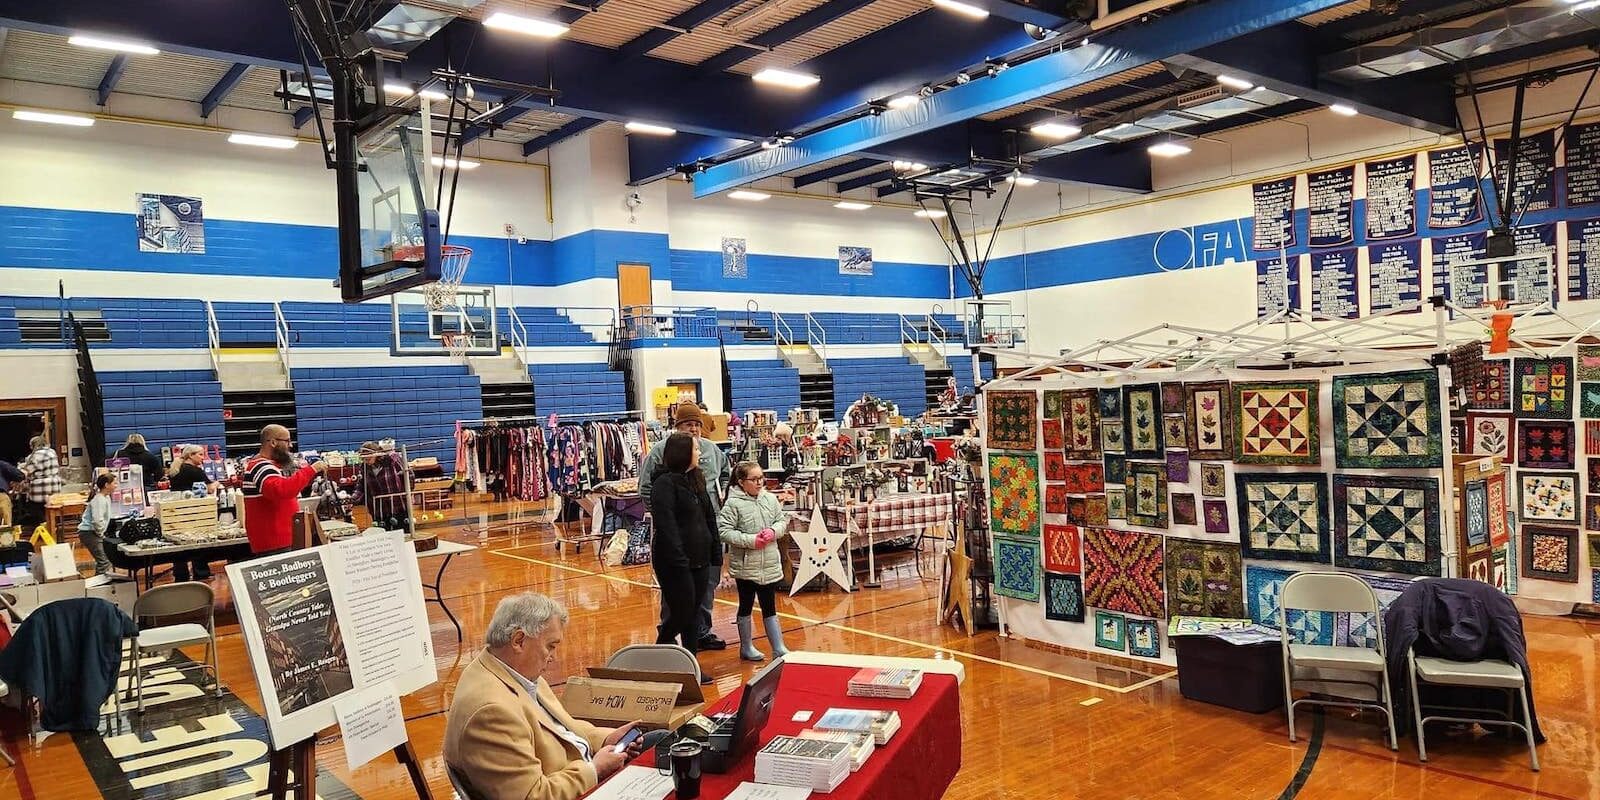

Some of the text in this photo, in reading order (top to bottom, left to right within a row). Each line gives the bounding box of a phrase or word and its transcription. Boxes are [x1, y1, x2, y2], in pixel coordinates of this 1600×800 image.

[250, 558, 317, 581] Booze, Badboys
[258, 571, 317, 592] & Bootleggers
[288, 607, 310, 620] Country
[265, 620, 291, 633] Grandpa
[291, 616, 307, 626] Never
[308, 612, 319, 622] Told
[294, 664, 311, 675] James
[636, 696, 672, 706] ENLARGED
